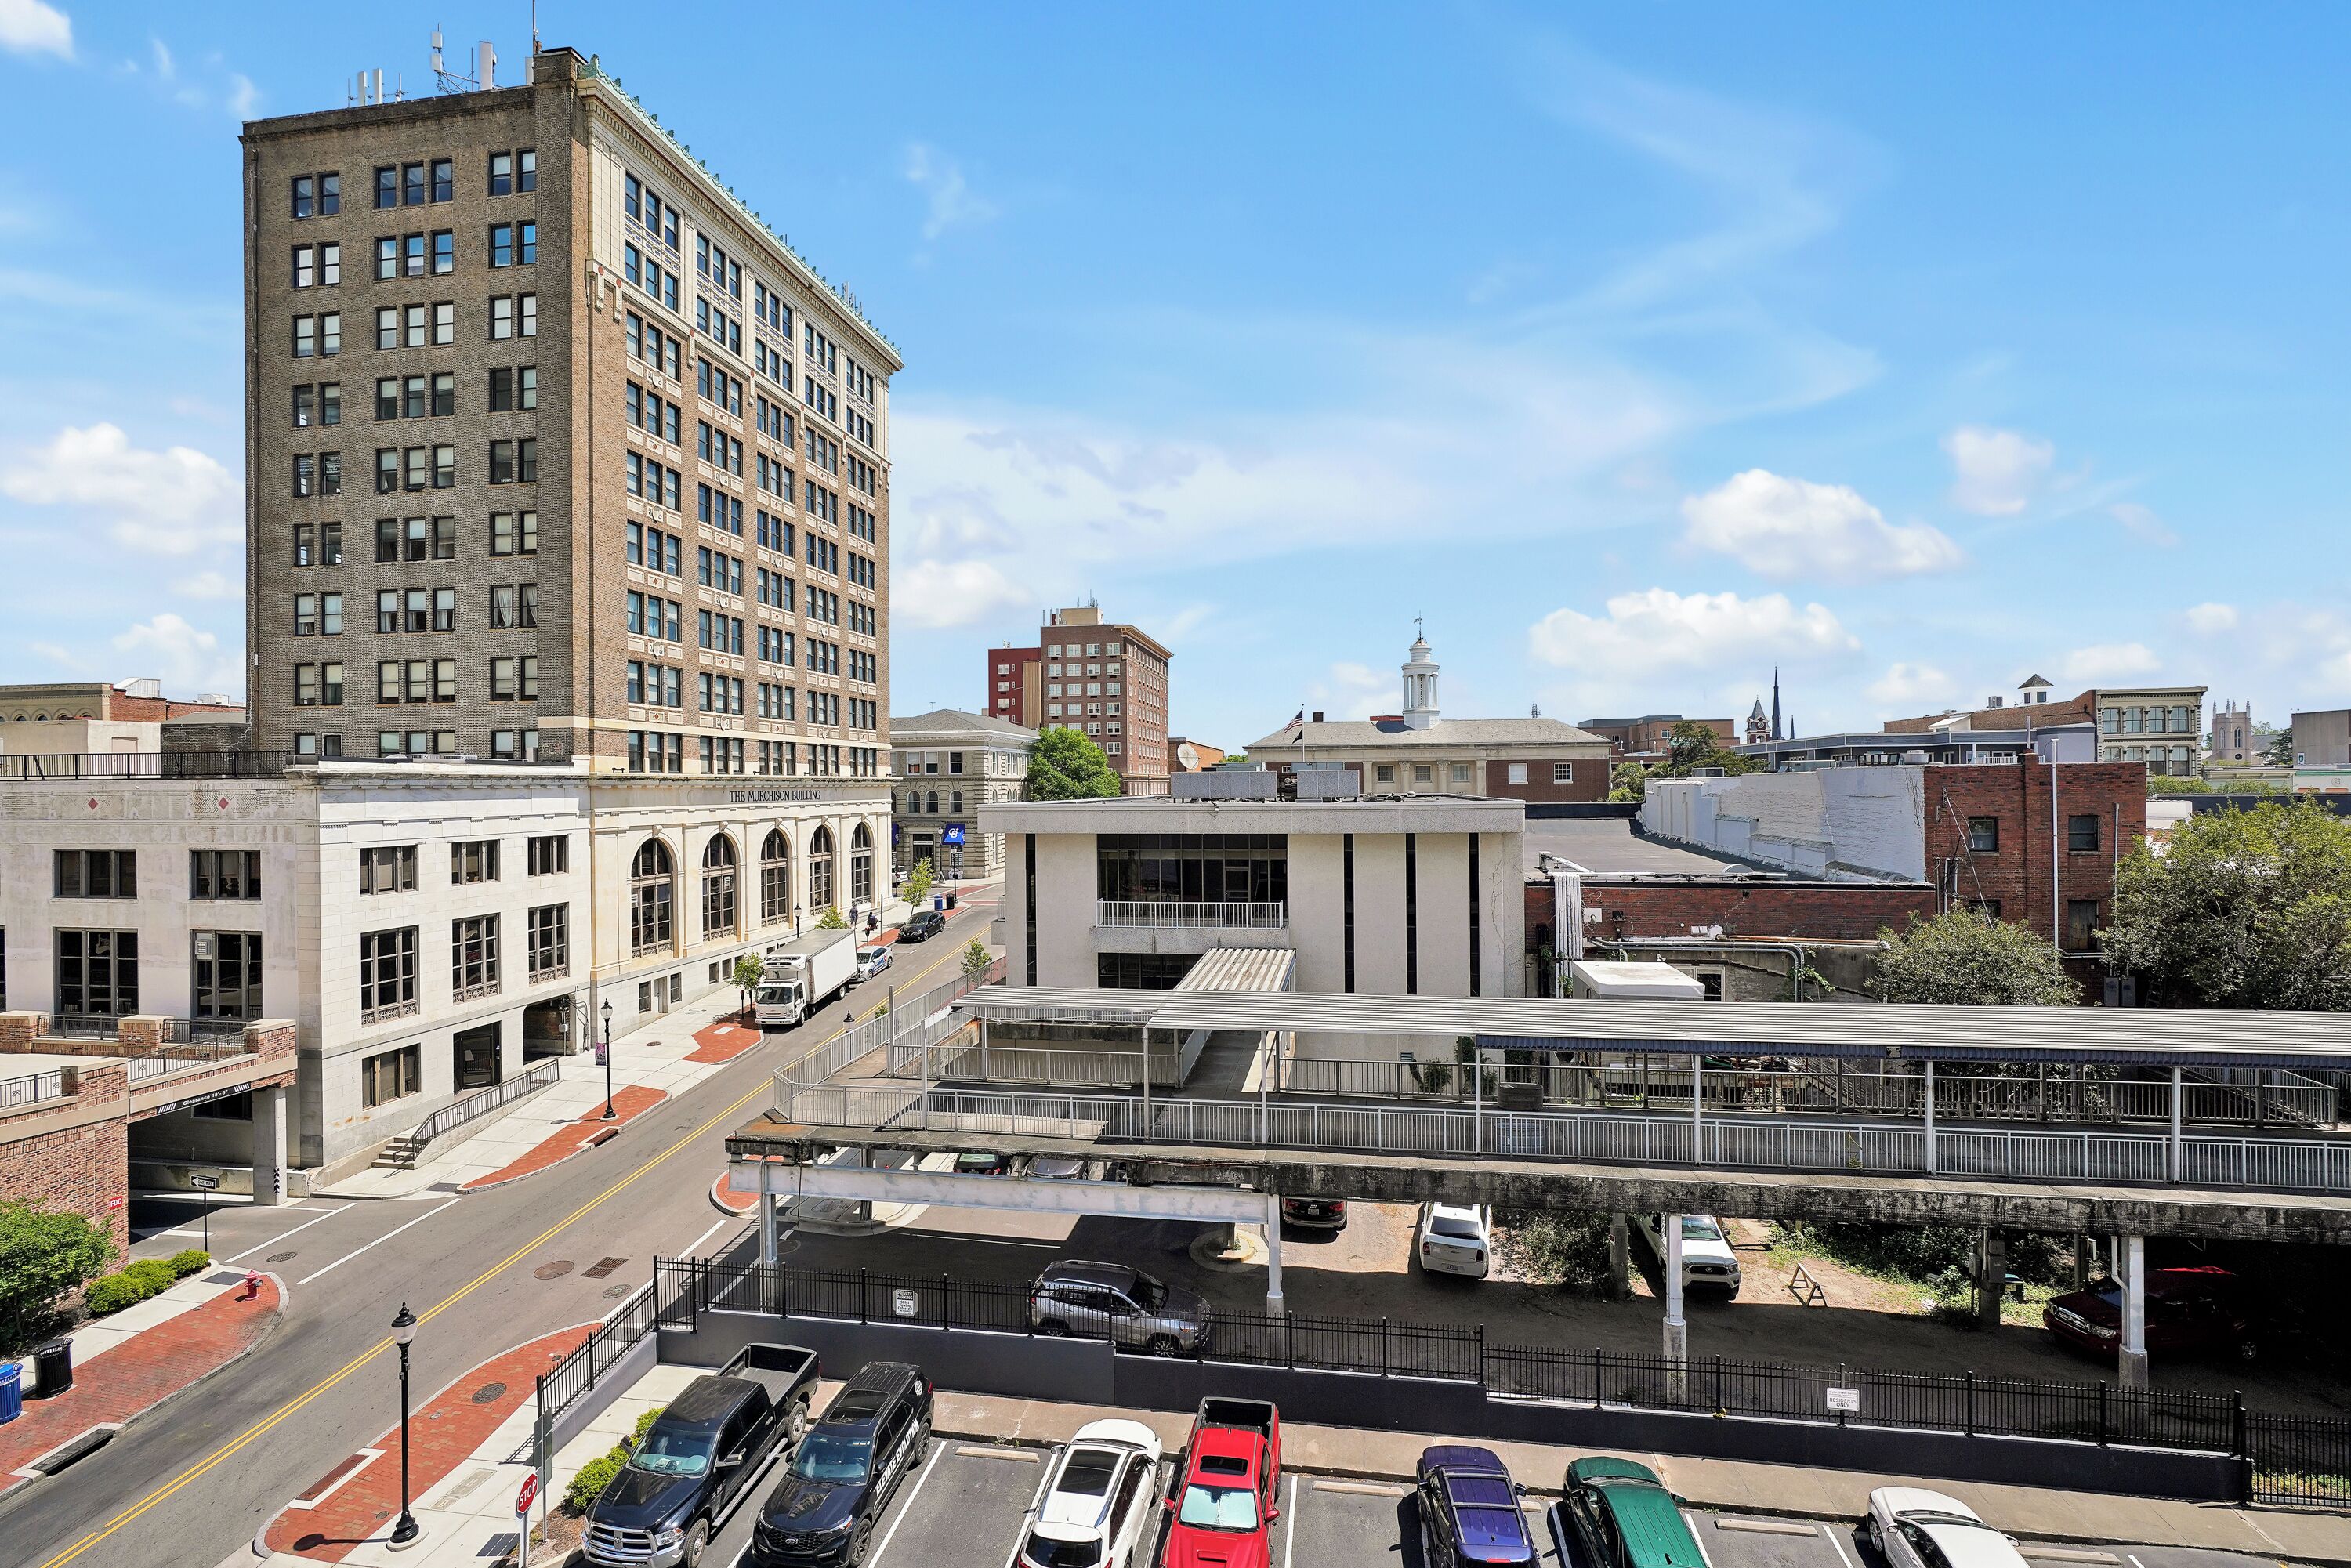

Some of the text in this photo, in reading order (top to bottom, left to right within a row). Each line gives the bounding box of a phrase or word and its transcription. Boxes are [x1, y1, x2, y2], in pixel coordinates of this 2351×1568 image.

[730, 789, 820, 802] THE MURCHISON BUILDING
[183, 1095, 210, 1106] Clearance
[110, 1197, 122, 1207] FDC
[875, 1418, 920, 1496] ELEVATE EVOLUTION
[519, 1479, 537, 1507] STOP
